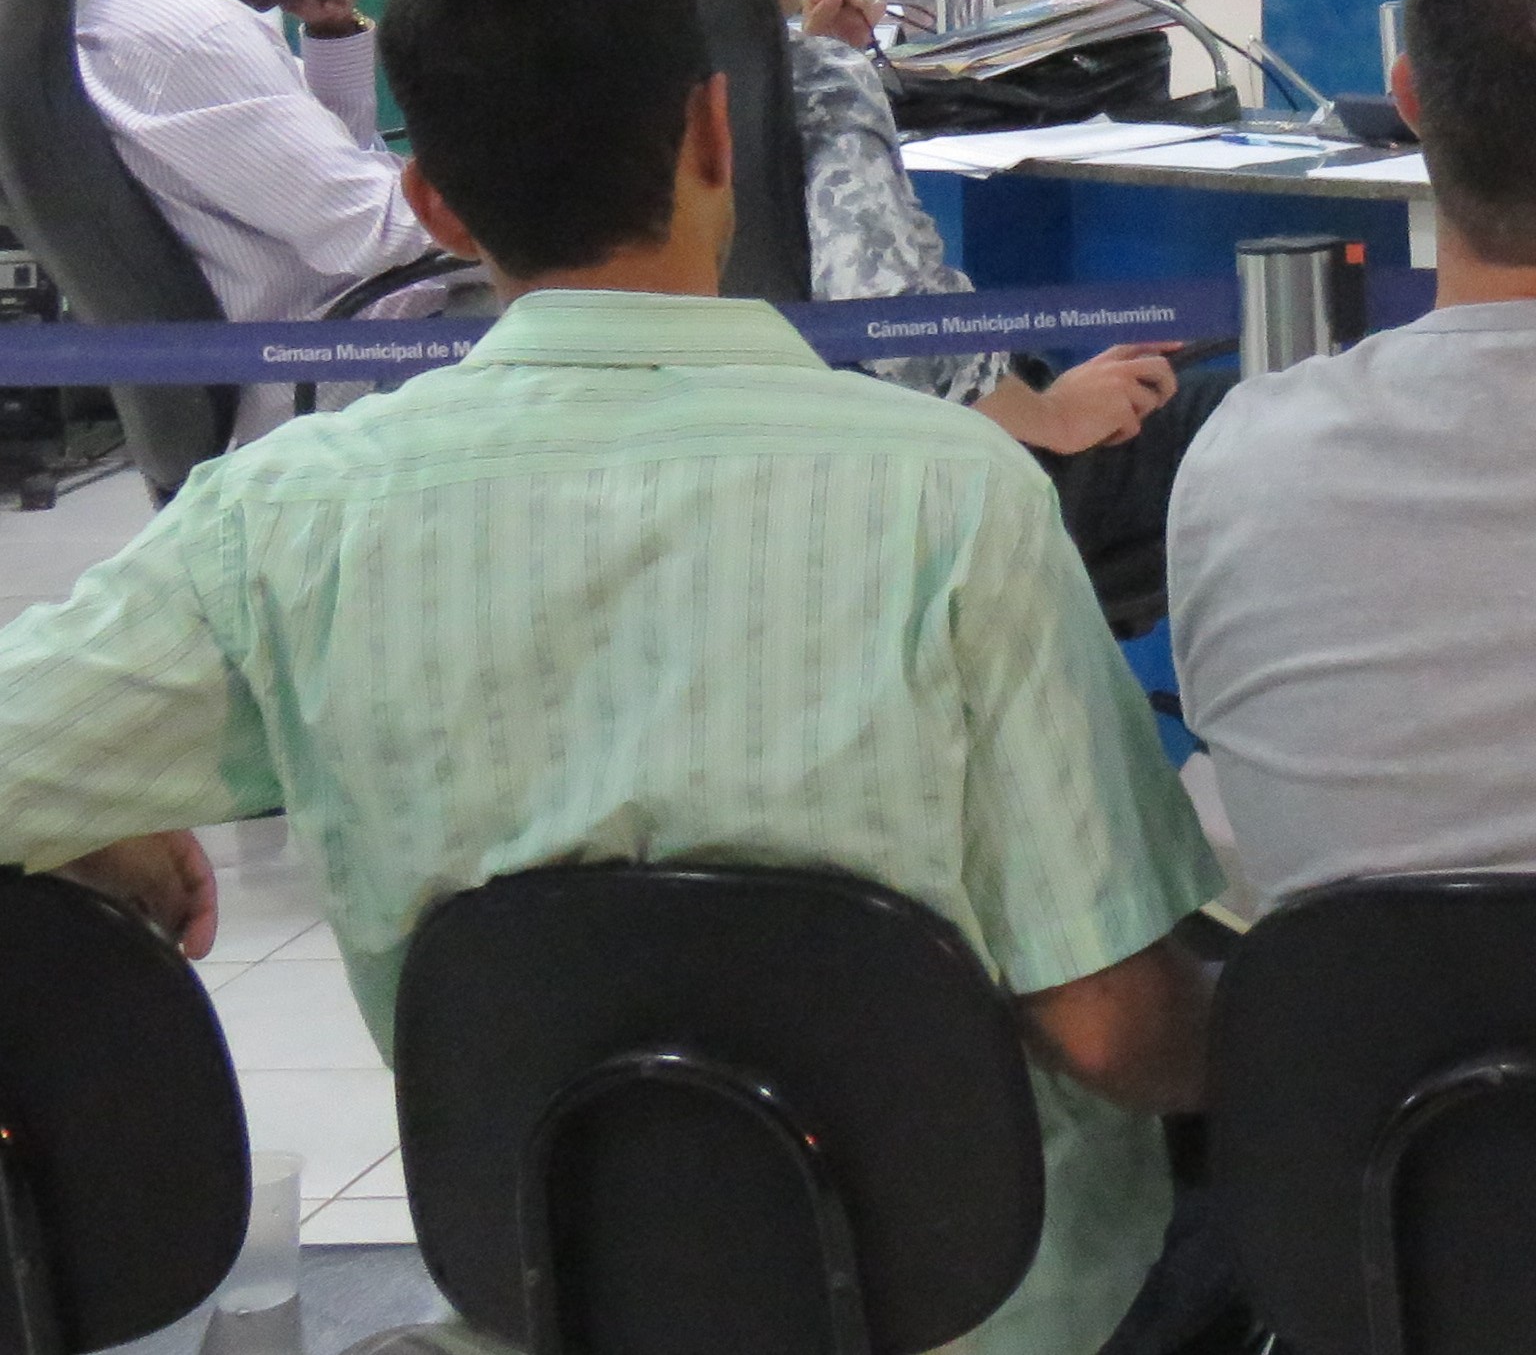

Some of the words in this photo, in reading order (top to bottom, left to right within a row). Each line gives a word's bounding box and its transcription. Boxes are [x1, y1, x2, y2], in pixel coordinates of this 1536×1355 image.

[867, 318, 938, 339] Câmara
[942, 312, 1030, 334] Municipal
[1034, 311, 1056, 328] de
[1059, 305, 1175, 327] Manhumirim
[262, 344, 332, 362] Câmara
[336, 341, 423, 363] Municipal
[427, 342, 448, 358] de
[453, 340, 475, 358] M
